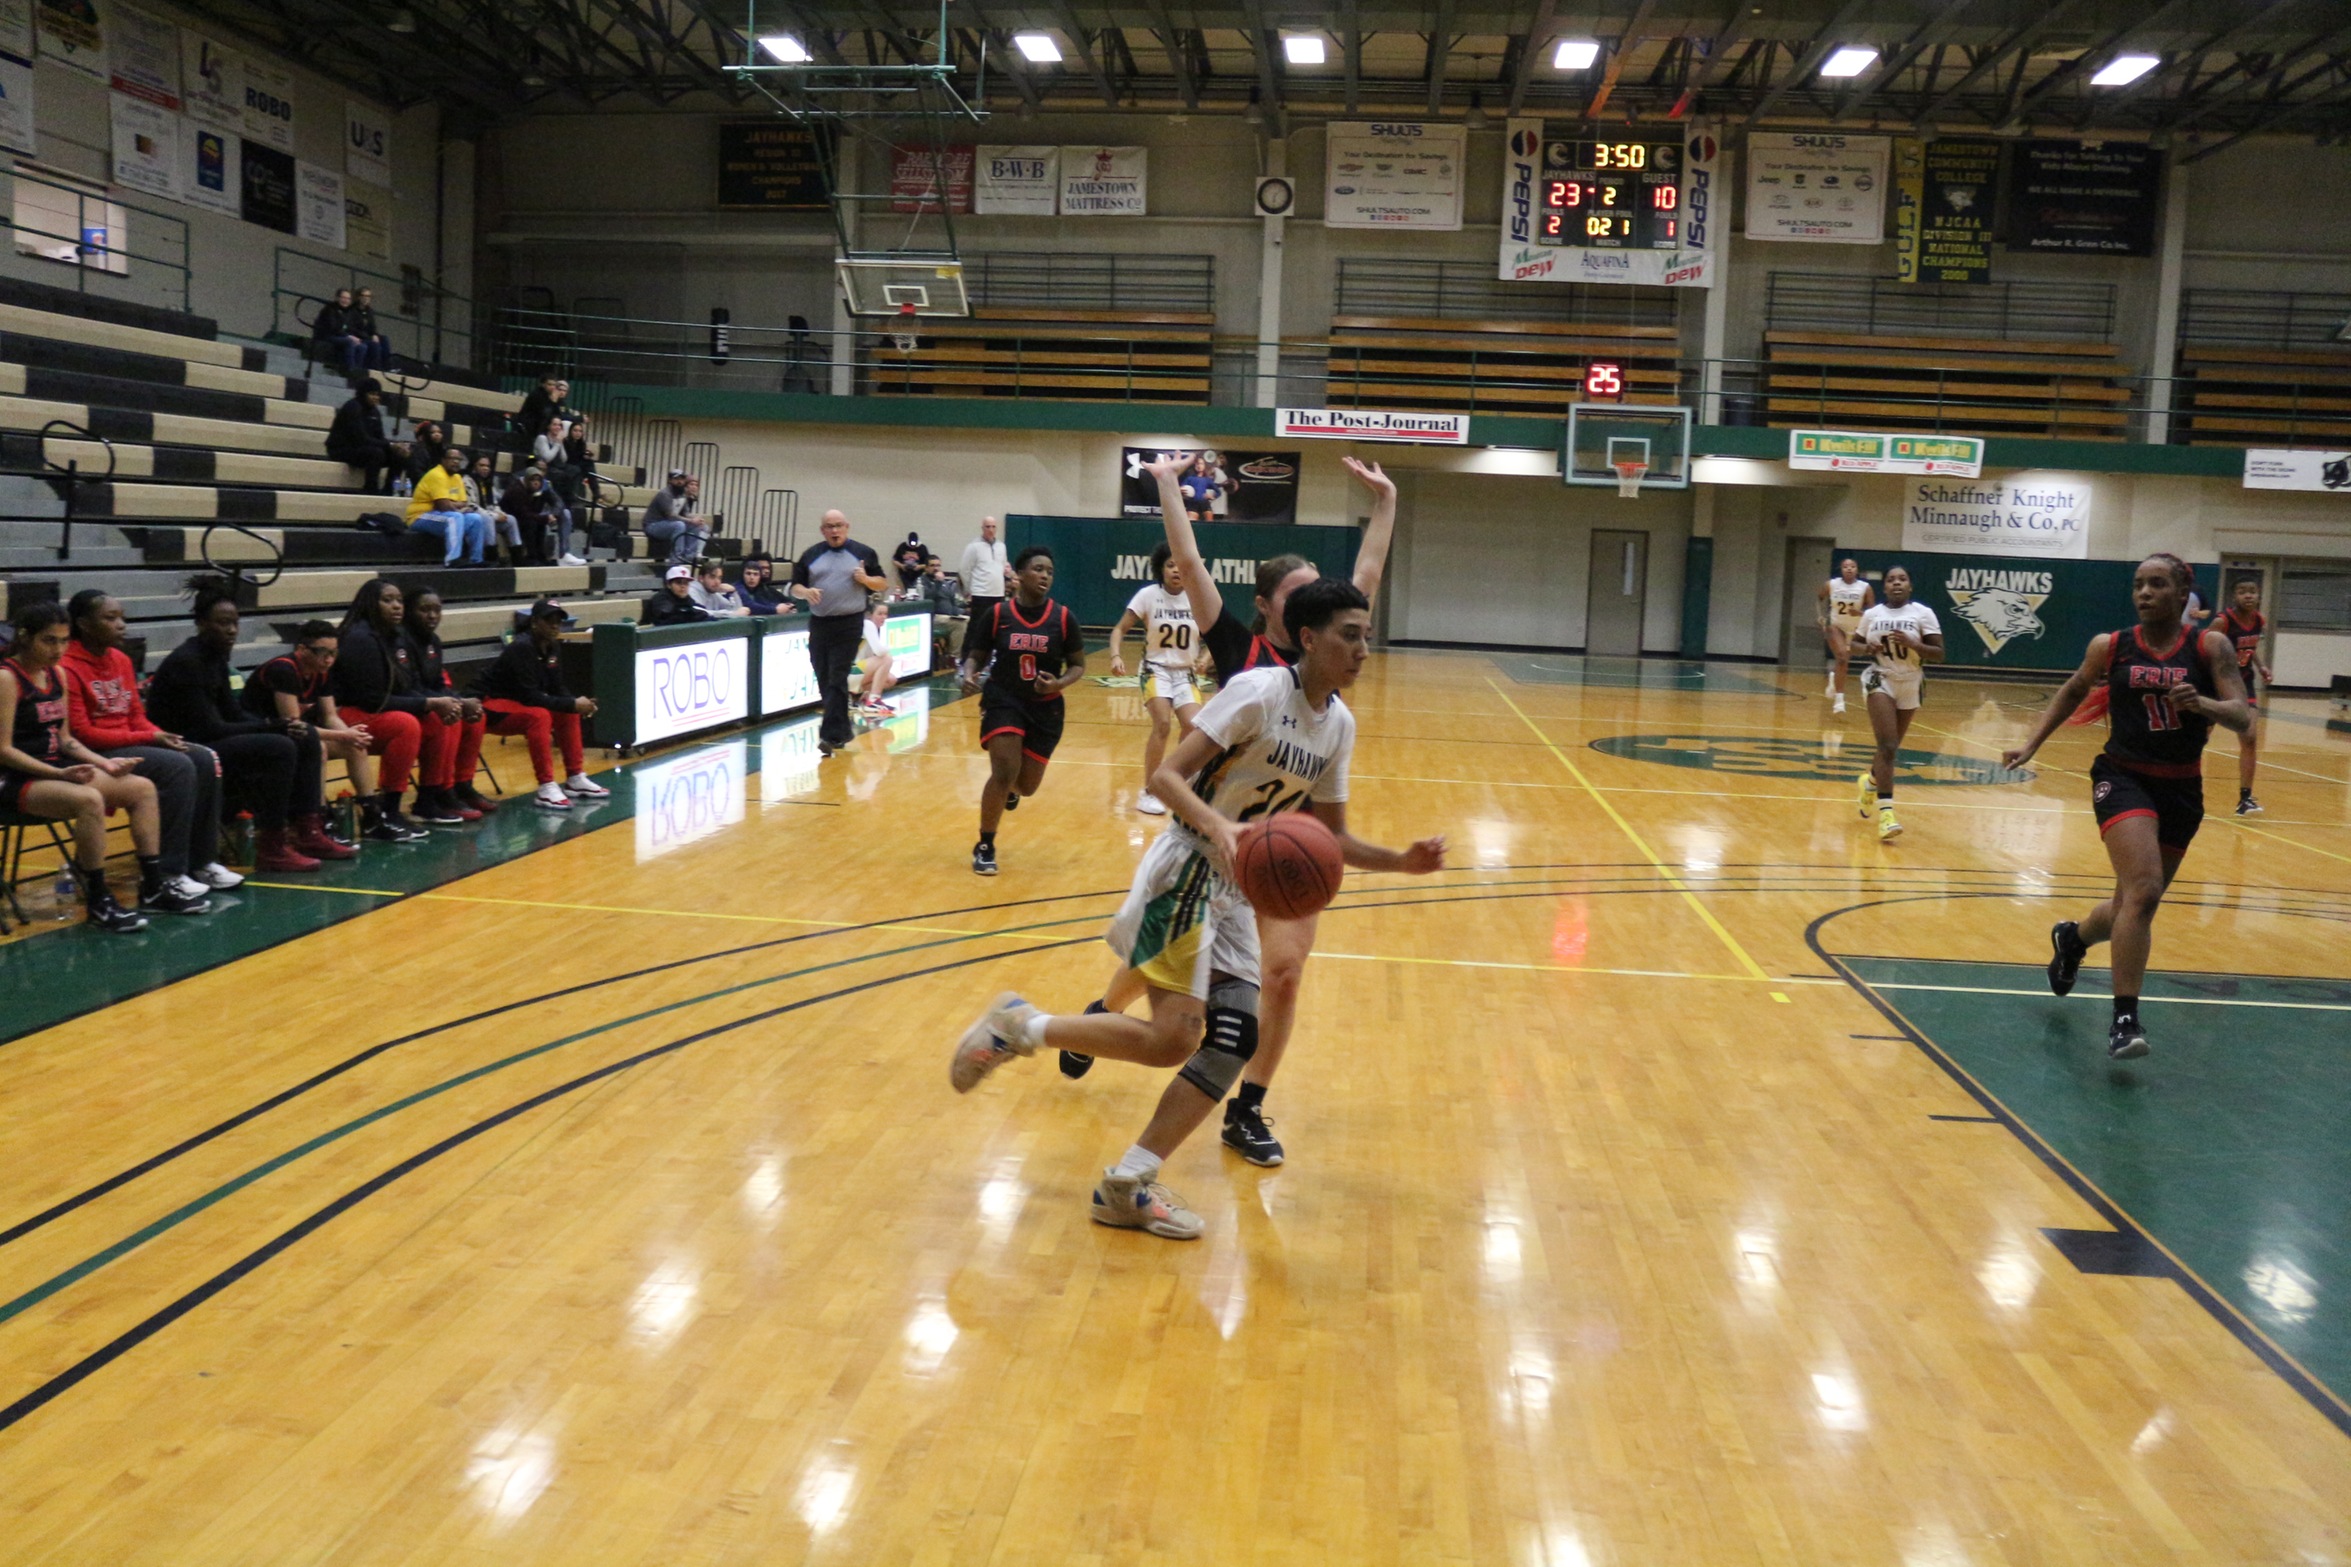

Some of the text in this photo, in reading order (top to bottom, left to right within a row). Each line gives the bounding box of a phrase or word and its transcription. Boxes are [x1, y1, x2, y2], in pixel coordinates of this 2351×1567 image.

[246, 87, 291, 121] ROBO
[1371, 124, 1423, 136] SHULTS
[1793, 136, 1845, 148] SHULTS
[1595, 144, 1645, 168] 3:50
[1542, 171, 1595, 181] JAYHAWKS
[1642, 173, 1676, 183] GUEST
[1067, 182, 1137, 195] JAMESTOWN
[1550, 183, 1580, 205] 23
[1604, 187, 1616, 205] 2
[1654, 186, 1677, 209] 10
[1065, 198, 1124, 210] MATTRESS
[1357, 207, 1431, 215] SHULTSAUTO.COM
[1511, 162, 1532, 243] PEPSI
[1687, 168, 1710, 249] PEPSI
[1548, 216, 1561, 234] 2
[1667, 221, 1675, 236] 1
[1778, 219, 1852, 228] SHULTSAUTO.COM
[1935, 216, 1981, 228] NJCAA
[1923, 230, 1972, 241] DIVISION
[1929, 243, 1984, 255] NATIONAL
[1923, 256, 1988, 268] CHAMPIONS
[1588, 364, 1621, 394] 25
[1285, 410, 1459, 431] The Post-Journal
[1820, 438, 1856, 452] Kwik
[1857, 440, 1878, 453] Fill
[1914, 442, 1950, 456] Kwik
[1918, 484, 2074, 513] Schaffner Knight
[1910, 506, 2002, 533] Minnaugh
[2007, 512, 2023, 528] &
[2061, 519, 2080, 531] PC
[1921, 534, 2064, 548] CERTIFIED PUBLIC ACCOUNTANTS
[1946, 568, 2053, 593] JAYHAWKS
[1009, 633, 1049, 652] ERIE
[1159, 623, 1191, 650] 20
[1019, 654, 1037, 681] 0
[2129, 665, 2188, 688] ERIE
[653, 648, 730, 719] ROBO
[2142, 694, 2183, 732] 11
